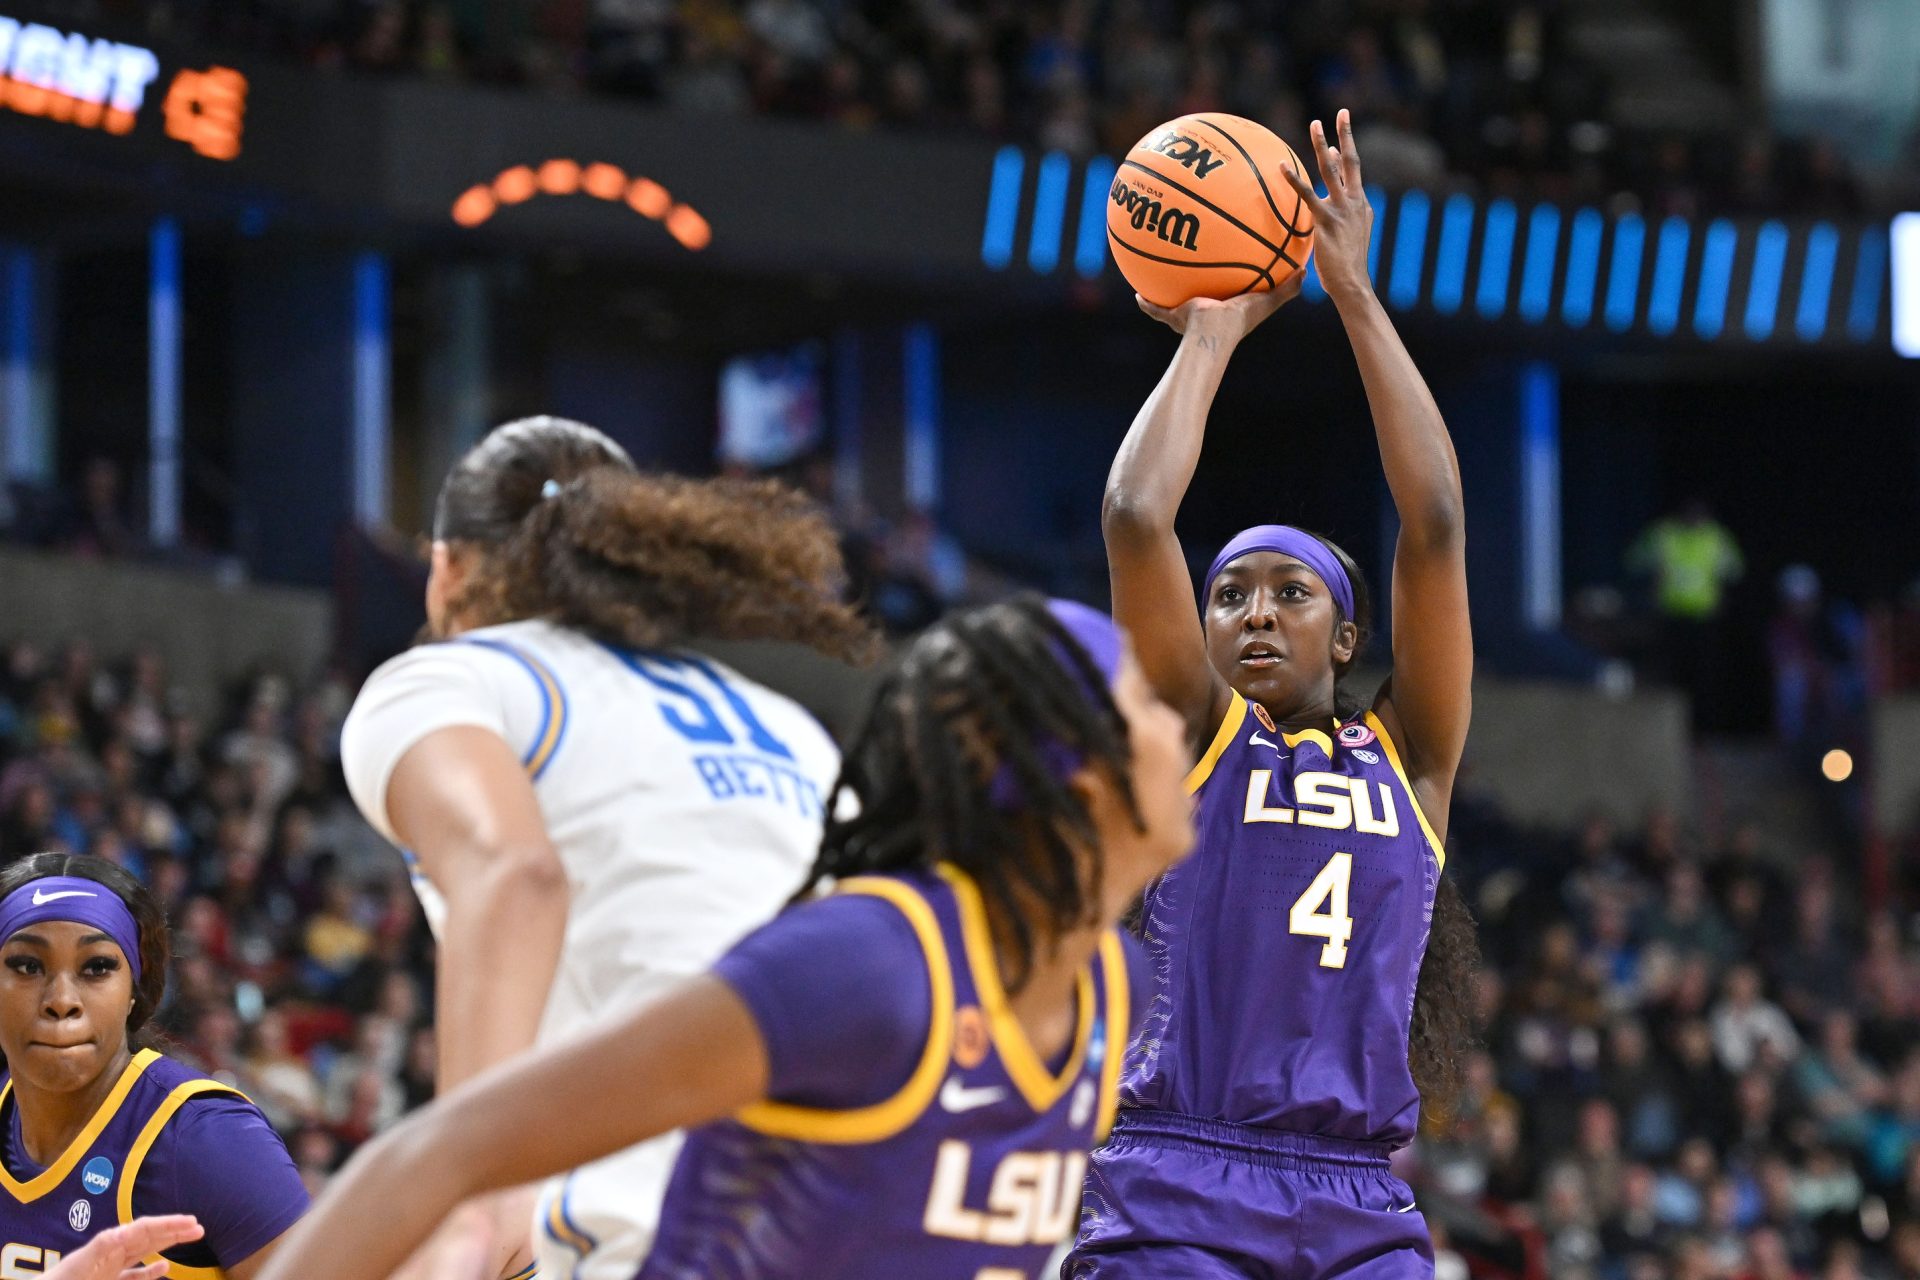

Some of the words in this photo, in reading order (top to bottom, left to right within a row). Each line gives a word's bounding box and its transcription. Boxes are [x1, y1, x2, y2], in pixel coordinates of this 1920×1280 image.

[1140, 132, 1224, 180] NCA
[1110, 175, 1200, 252] Wilson
[1146, 187, 1164, 199] EVO
[1243, 769, 1399, 837] LSU
[1289, 852, 1353, 969] 4
[85, 1171, 111, 1189] NCAA
[922, 1139, 1089, 1246] LSU
[70, 1202, 90, 1229] SEC
